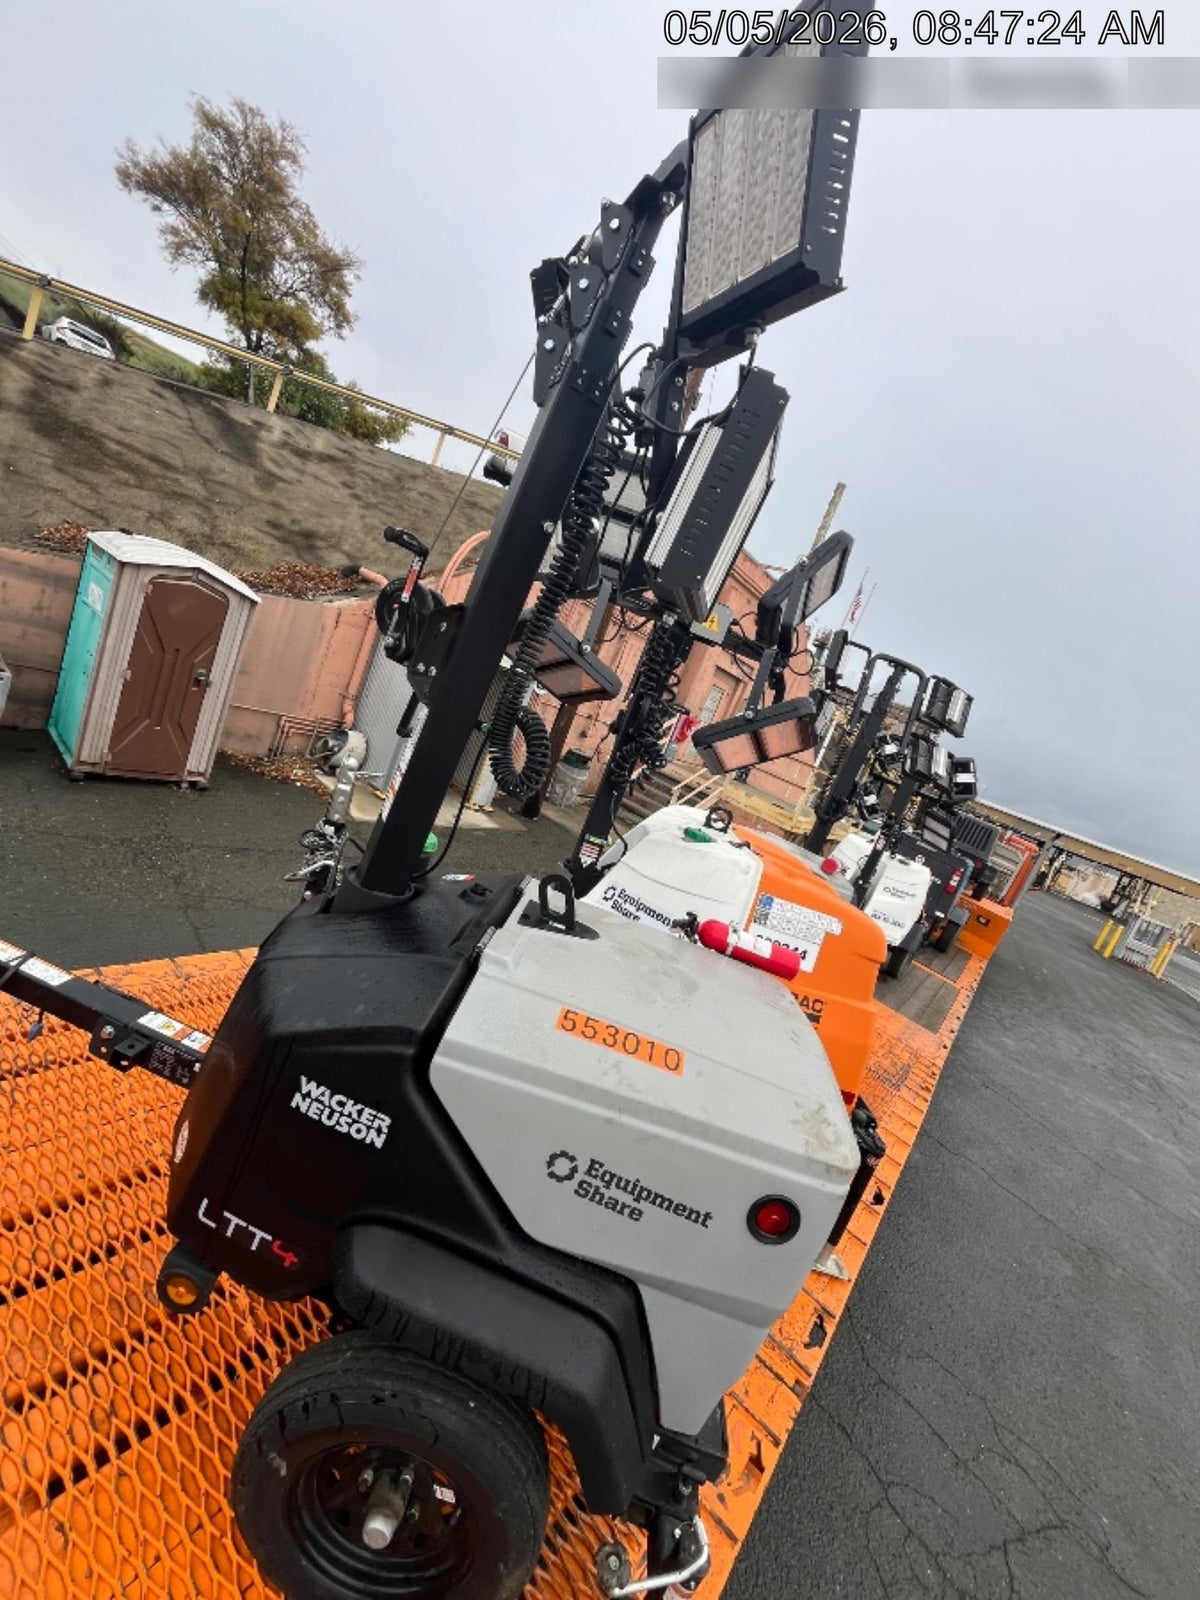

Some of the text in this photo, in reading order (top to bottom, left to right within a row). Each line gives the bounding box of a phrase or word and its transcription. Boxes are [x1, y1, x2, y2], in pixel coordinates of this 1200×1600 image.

[618, 888, 671, 927] Equipmen
[561, 1009, 680, 1071] 553010
[290, 1091, 387, 1149] NEUSON
[300, 1074, 391, 1134] WACKER
[573, 1178, 644, 1222] Share
[584, 1158, 714, 1229] Equipment
[198, 1198, 298, 1268] LTT4
